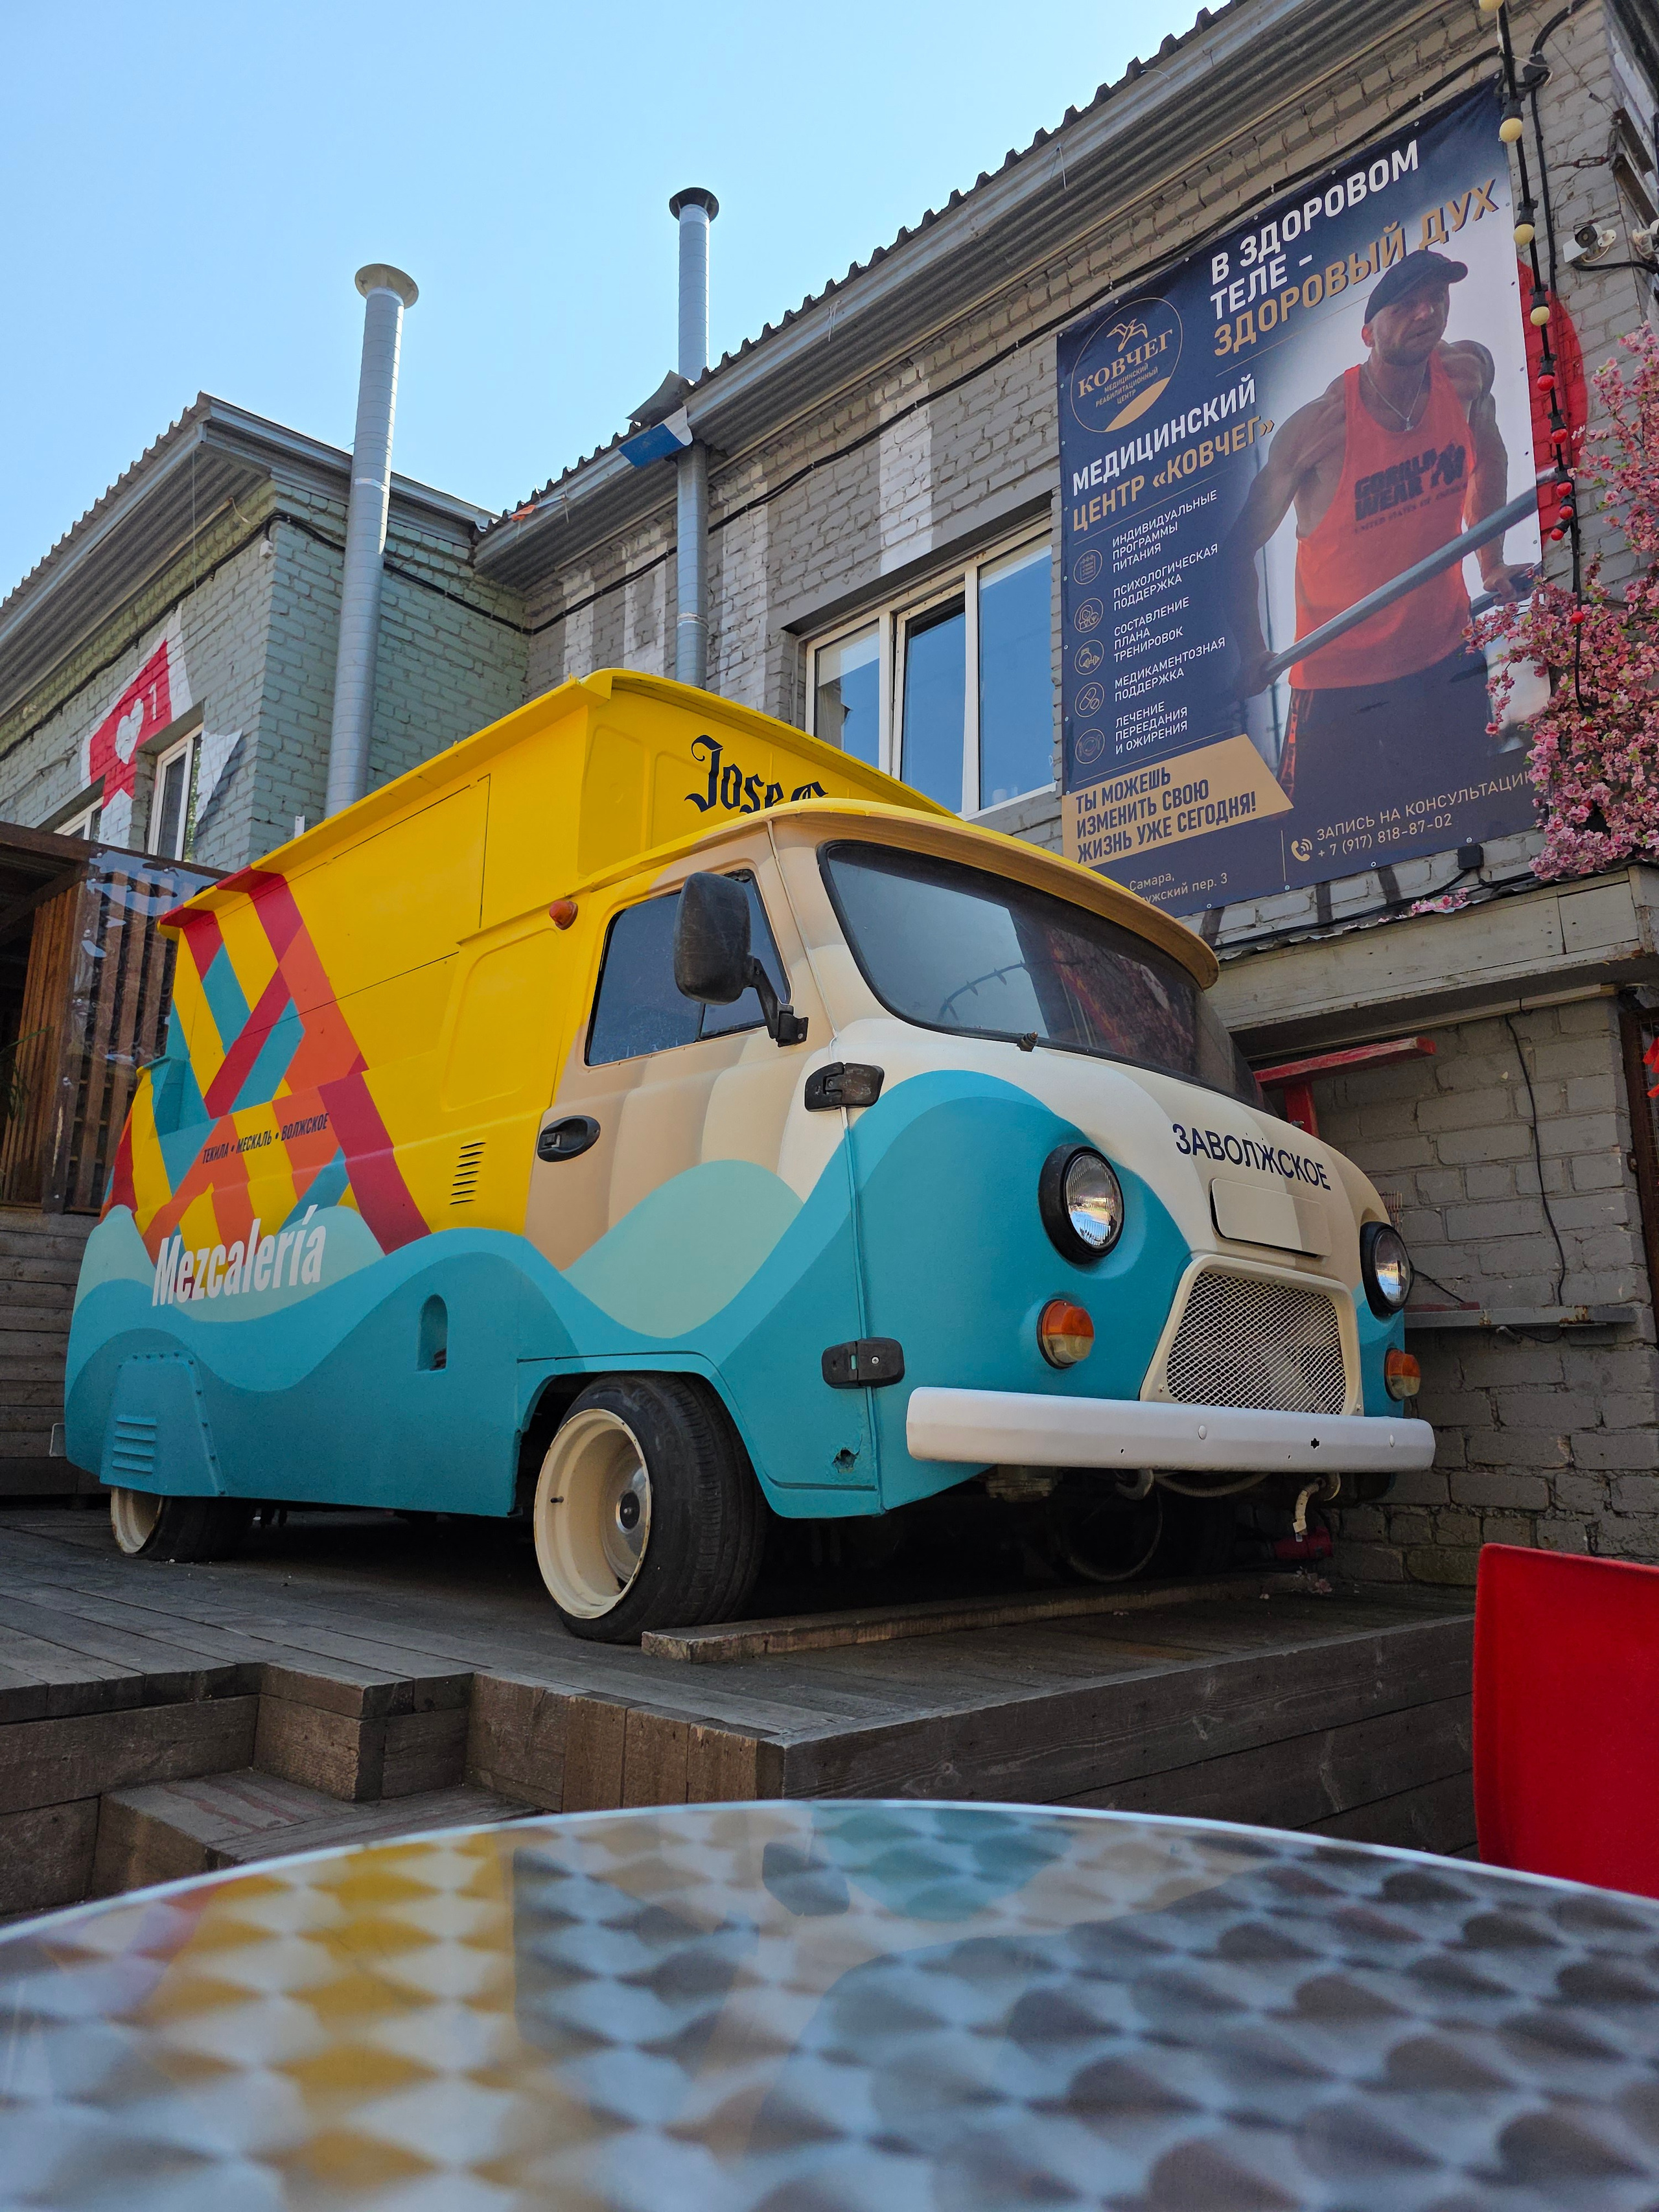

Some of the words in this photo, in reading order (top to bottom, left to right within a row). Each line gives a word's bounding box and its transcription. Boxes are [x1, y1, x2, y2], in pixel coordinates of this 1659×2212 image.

[1211, 252, 1229, 285] В
[1240, 139, 1419, 266] ЗДОРОВОМ
[1210, 253, 1288, 320] ТЕЛЕ
[1214, 222, 1406, 356] ЗДОРОВЫЙ
[1418, 179, 1499, 251] ДУХ
[1078, 329, 1173, 398] КОВЧЕГ
[1104, 363, 1148, 393] МЕДИЦИНСКИЙ
[1095, 366, 1158, 408] РЕАБИЛИТАЦИОННЫЙ
[1117, 389, 1136, 404] ЦЕНТР
[1073, 373, 1257, 496] МЕДИЦИНСКИЙ
[1073, 474, 1144, 532] ЦЕНТР
[1152, 415, 1275, 488] «КОВЧЕГ»
[1112, 489, 1218, 548] ИНДИВИДУАЛЬНЫЕ
[1113, 521, 1178, 561] ПРОГРАММЫ
[1113, 542, 1161, 573] ПИТАНИЯ
[1113, 543, 1218, 599] ПСИХОЛОГИЧЕСКАЯ
[1113, 574, 1182, 612] ПОДДЕРЖКА
[1114, 596, 1190, 636] СОСТАВЛЕНИЕ
[1114, 627, 1150, 650] ПЛАНА
[1114, 626, 1183, 663] ТРЕНИРОВОК
[1115, 636, 1225, 689] МЕДИКАМЕНТОЗНАЯ
[1115, 668, 1185, 702] ПОДДЕРЖКА
[1115, 701, 1165, 728] ЛЕЧЕНИЕ
[1115, 706, 1188, 742] ПЕРЕЕДАНИЯ
[1115, 744, 1123, 755] И
[1126, 720, 1188, 751] ОЖИРЕНИЯ
[1076, 790, 1096, 814] ТЫ
[1102, 767, 1171, 807] МОЖЕШЬ
[1076, 797, 1157, 839] ИЗМЕНИТЬ
[1162, 779, 1209, 811] СВОЮ
[1077, 833, 1132, 864] ЖИЗНЬ
[1137, 817, 1172, 845] УЖЕ
[1177, 791, 1257, 833] СЕГОДНЯ!
[1316, 815, 1375, 841] ЗАПИСЬ
[1380, 807, 1401, 825] НА
[1317, 849, 1325, 857] +
[1329, 843, 1338, 857] 7
[1341, 833, 1373, 856] (917)
[1377, 813, 1453, 844] 818-87-02
[1129, 872, 1175, 892] Самара,
[1192, 878, 1217, 892] пер.
[1220, 871, 1228, 885] 3
[202, 1143, 229, 1164] ТЕКИЛА
[236, 1130, 272, 1155] МЕСКАЛЬ
[281, 1112, 329, 1142] ВОЛЖСКОЕ
[1172, 1123, 1331, 1191] ЗАВОЛЖСКОЕ
[152, 1204, 327, 1307] Mezcalería
